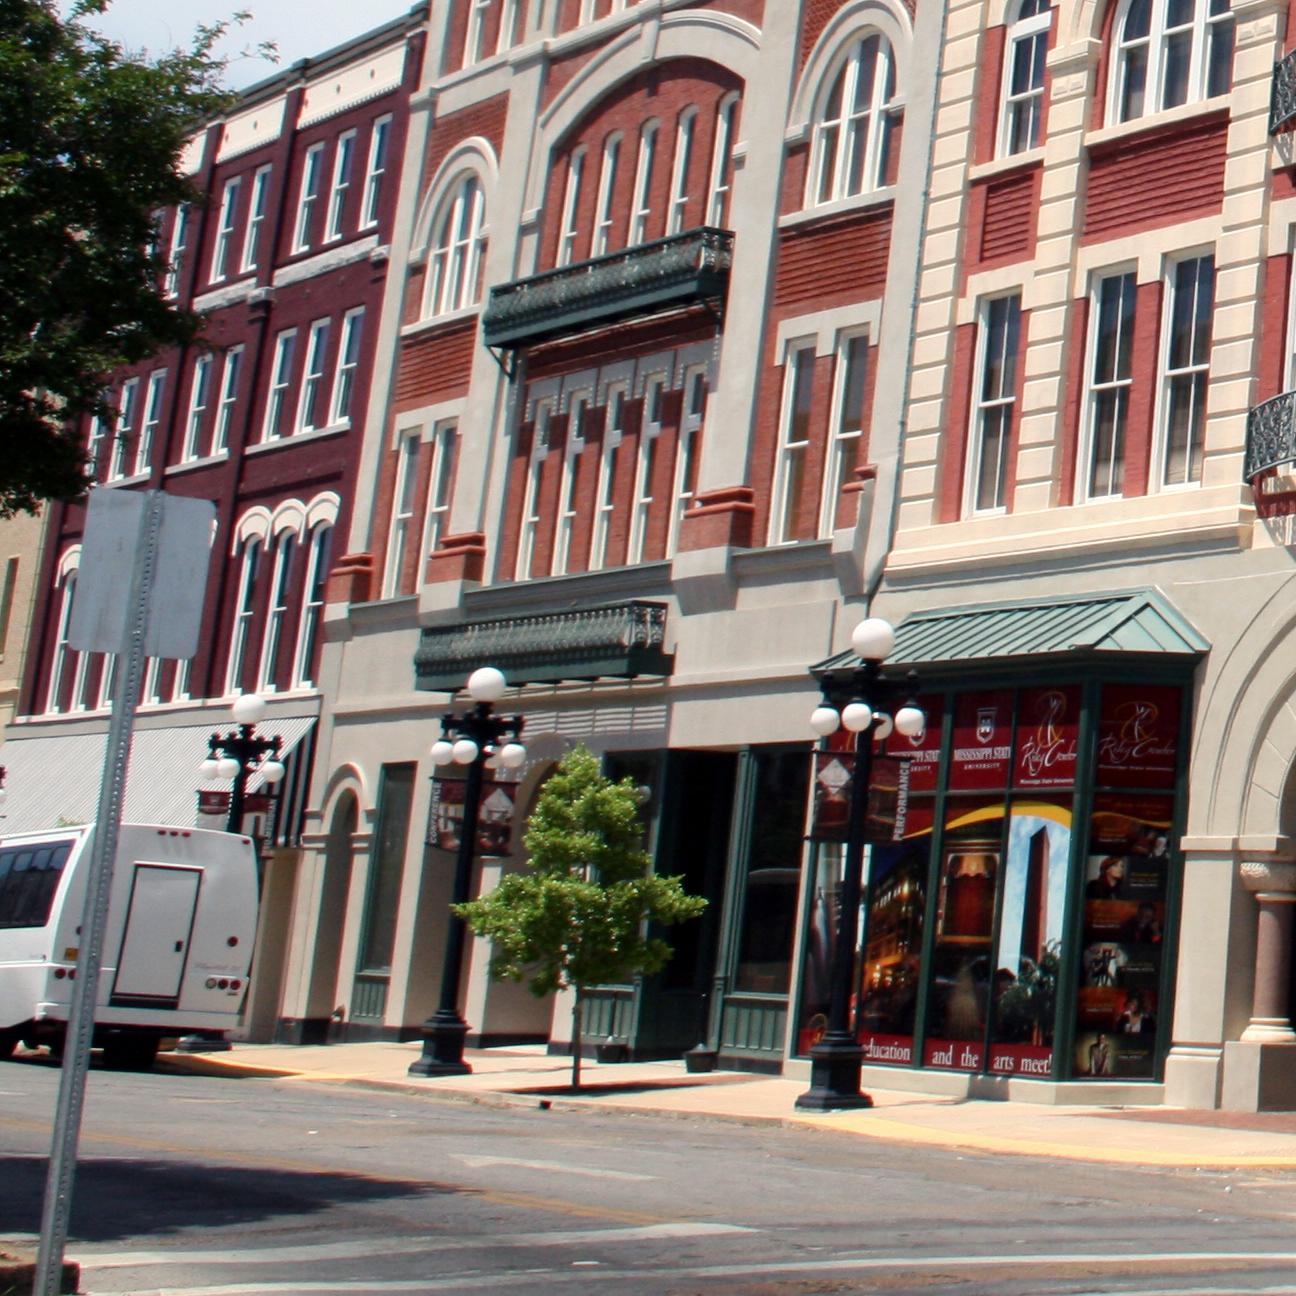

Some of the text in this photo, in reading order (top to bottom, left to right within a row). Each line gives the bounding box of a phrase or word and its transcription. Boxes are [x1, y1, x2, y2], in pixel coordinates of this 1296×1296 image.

[893, 760, 910, 841] PERFORMANCE
[932, 1045, 953, 1065] and
[961, 1046, 978, 1067] the
[993, 1054, 1014, 1070] arts
[1020, 1053, 1052, 1073] meet!
